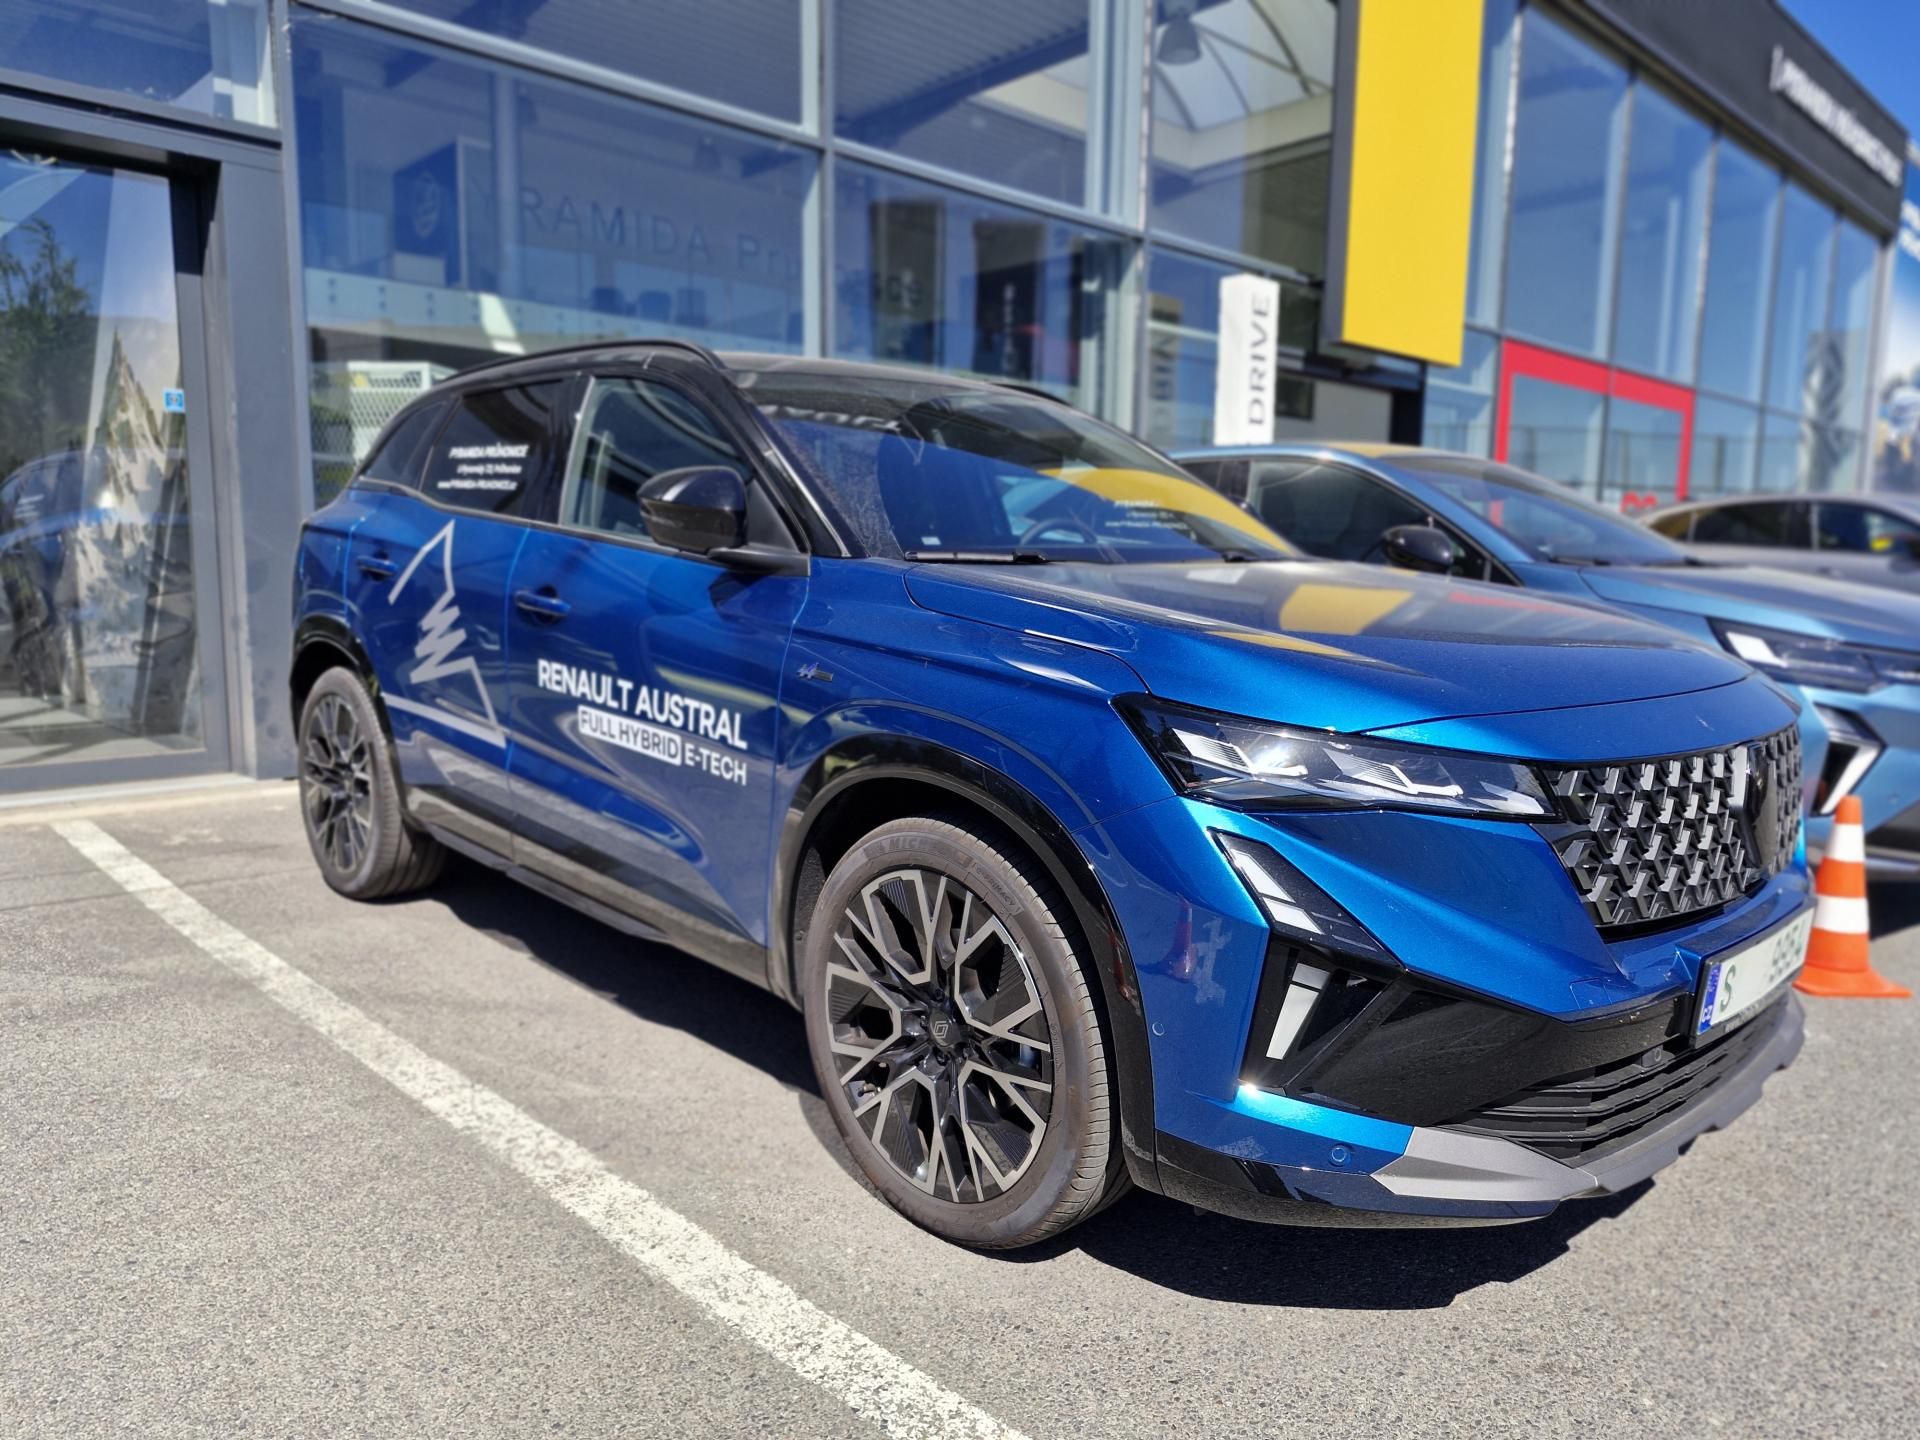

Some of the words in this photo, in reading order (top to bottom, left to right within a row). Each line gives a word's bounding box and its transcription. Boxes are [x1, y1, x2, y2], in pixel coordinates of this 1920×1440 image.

[1249, 293, 1270, 425] DRIVE
[538, 658, 633, 711] RENAULT
[635, 685, 748, 750] AUSTRAL
[581, 710, 616, 738] FULL
[618, 721, 680, 760] HYBRID
[684, 743, 747, 786] E-TECH
[1719, 964, 1736, 1013] S
